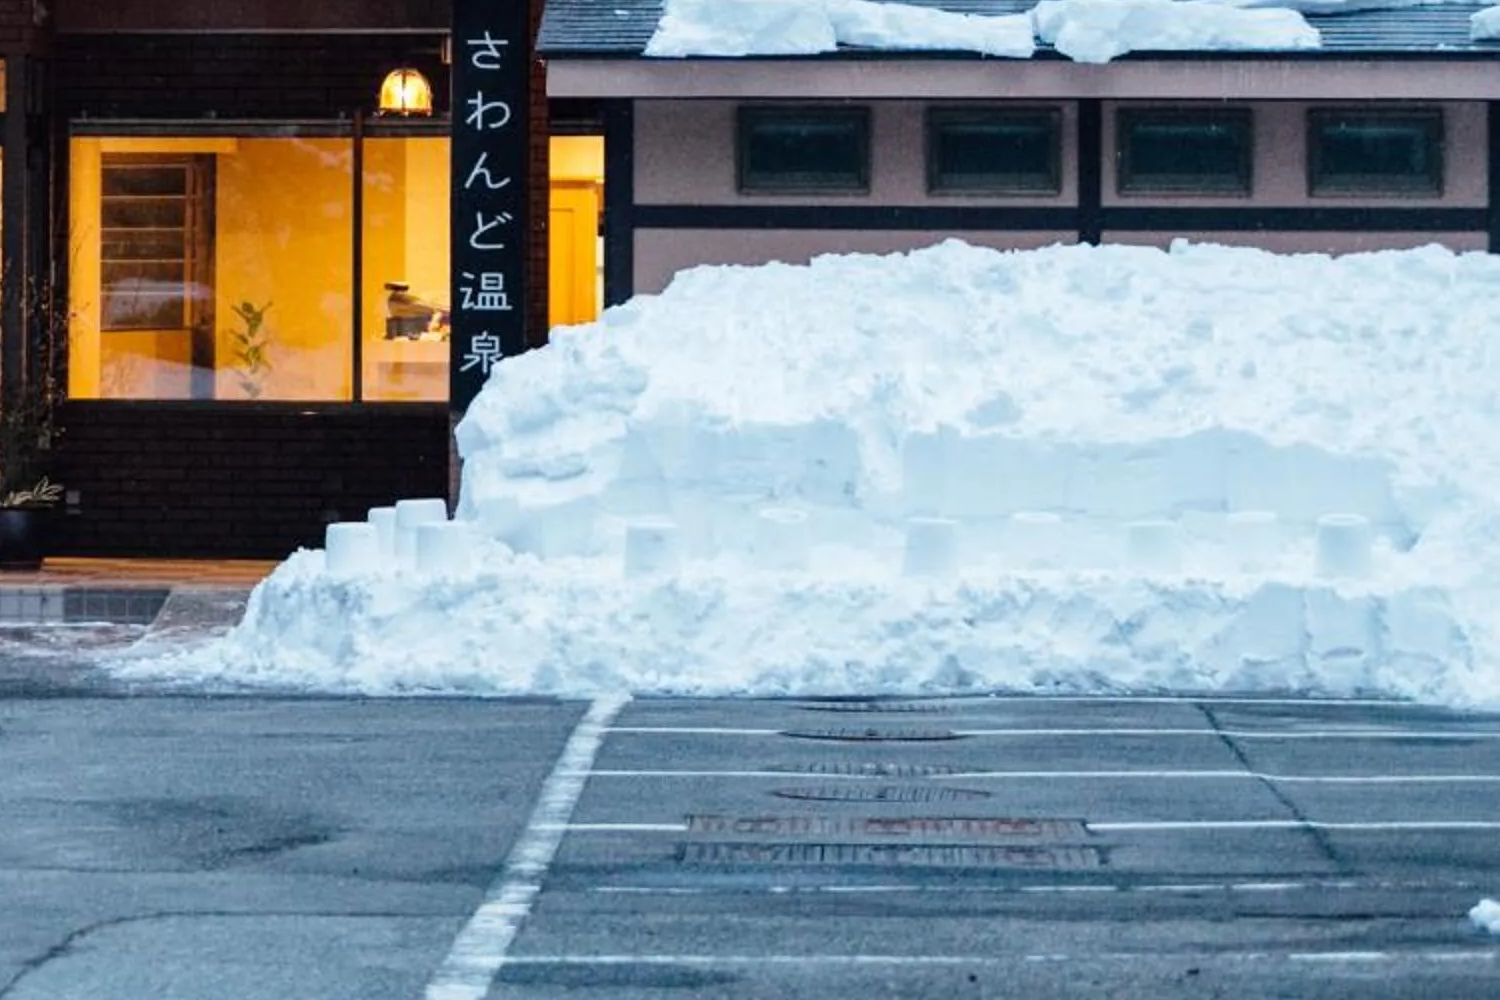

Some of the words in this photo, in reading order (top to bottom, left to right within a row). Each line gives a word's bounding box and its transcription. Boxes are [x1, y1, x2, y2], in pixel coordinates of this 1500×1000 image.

[459, 30, 513, 374] さわんど温泉
